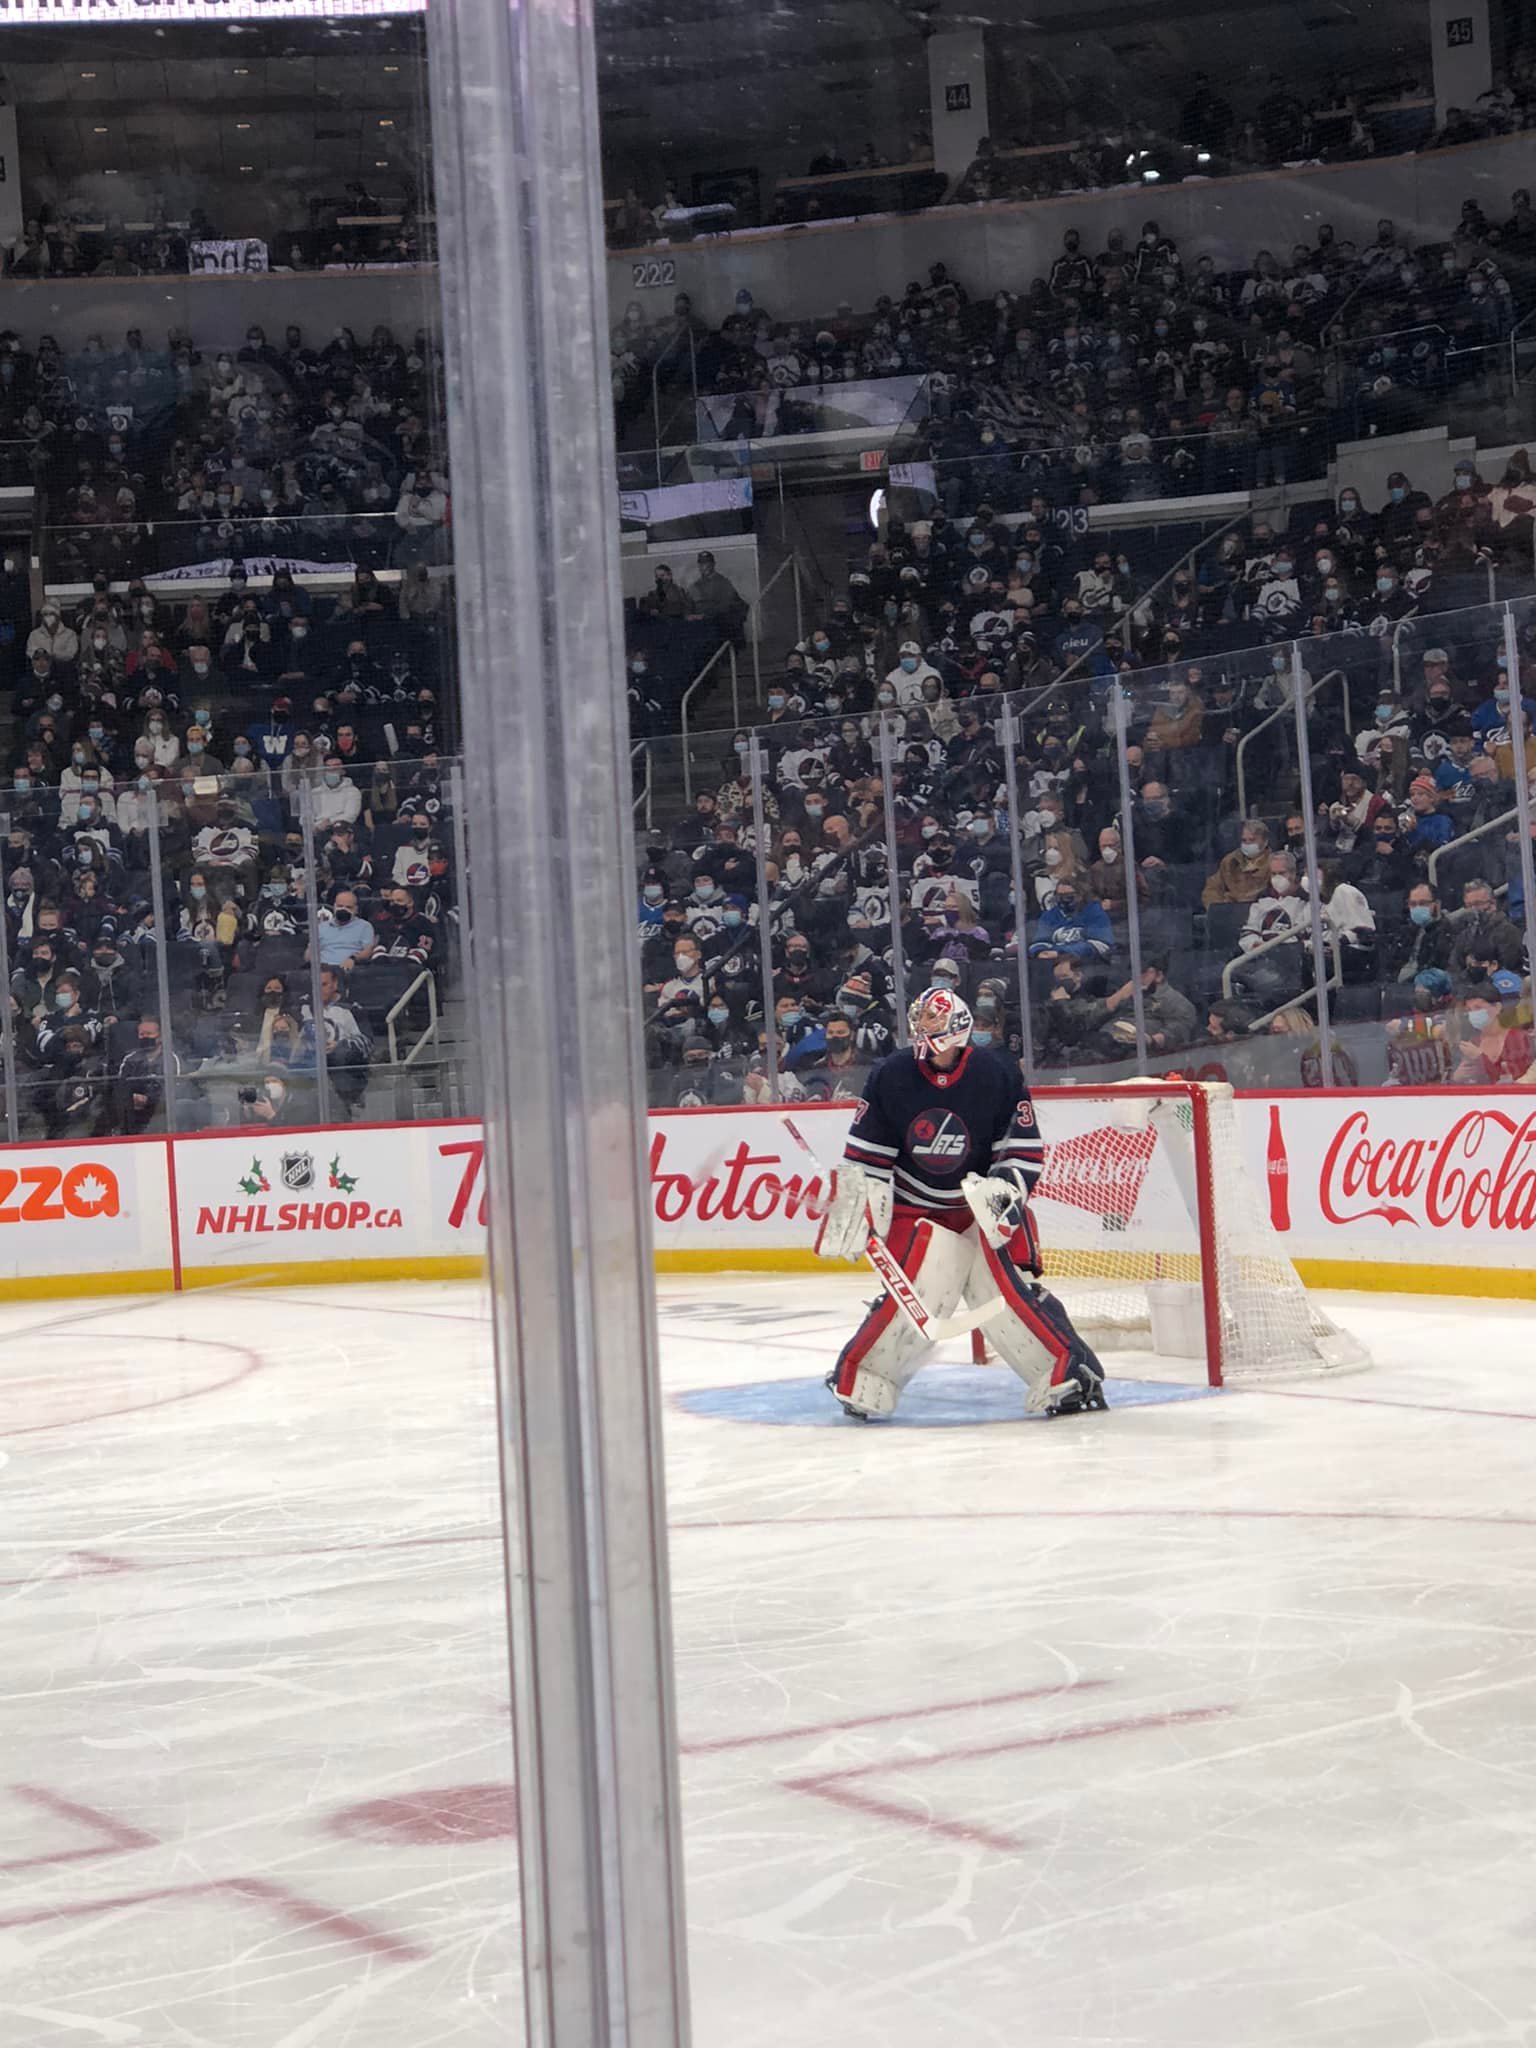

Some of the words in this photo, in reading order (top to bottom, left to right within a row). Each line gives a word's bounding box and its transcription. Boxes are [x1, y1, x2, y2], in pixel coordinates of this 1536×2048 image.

[1449, 21, 1471, 43] 45
[948, 87, 970, 107] 44
[633, 262, 674, 287] 222
[263, 735, 288, 754] W
[912, 1112, 965, 1156] JETS
[1319, 1110, 1536, 1230] Coca-Cola
[196, 1202, 402, 1234] NHLSHOP.CA
